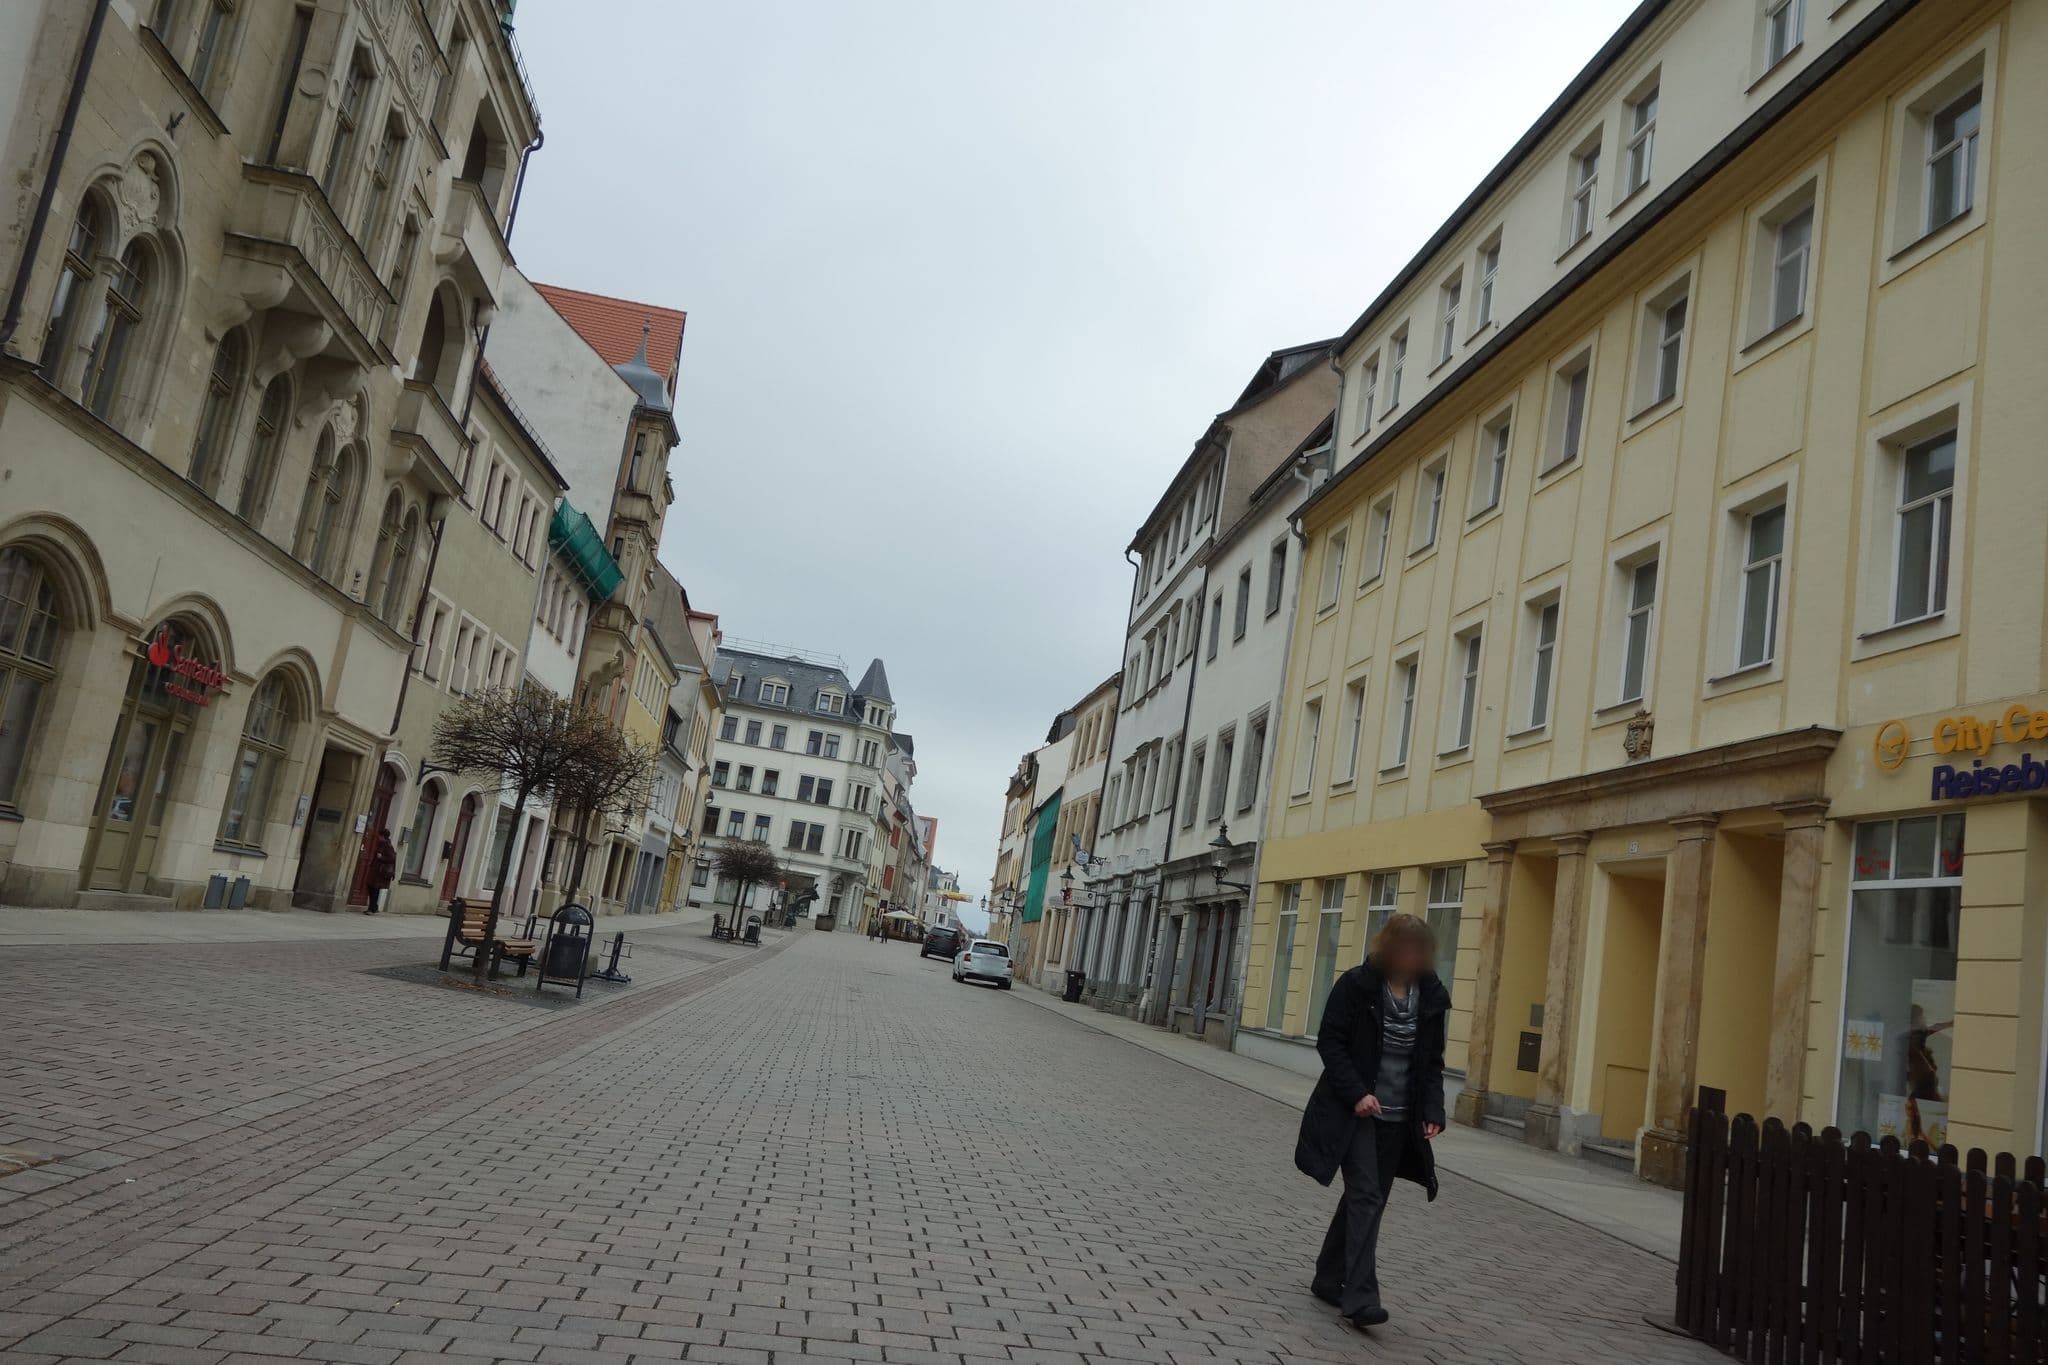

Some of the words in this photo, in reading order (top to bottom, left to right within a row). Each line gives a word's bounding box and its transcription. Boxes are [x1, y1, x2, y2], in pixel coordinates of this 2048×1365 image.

[1933, 716, 1997, 757] City
[2003, 703, 2048, 744] Ce
[1931, 753, 2048, 801] Reiseb
